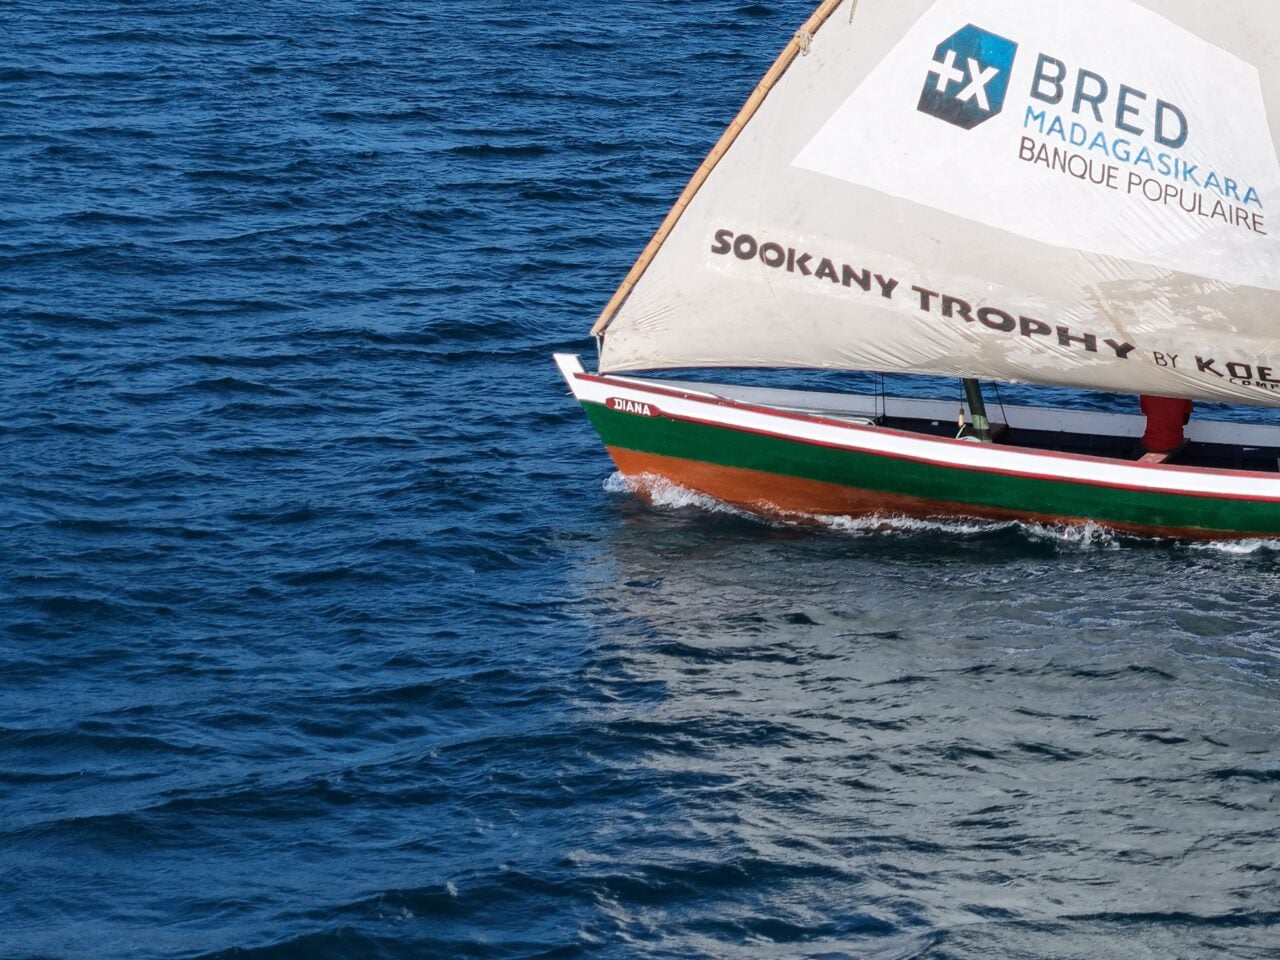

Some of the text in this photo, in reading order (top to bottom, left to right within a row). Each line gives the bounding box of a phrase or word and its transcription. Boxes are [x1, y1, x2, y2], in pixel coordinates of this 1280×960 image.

[1029, 52, 1189, 150] BRED
[1018, 135, 1267, 235] BANQUE POPULAIRE
[1023, 105, 1263, 209] MADAGASIKARA
[710, 228, 899, 299] SOOKANY
[911, 285, 1136, 359] TROPHY
[1153, 351, 1178, 369] BY
[613, 398, 651, 416] DIANA
